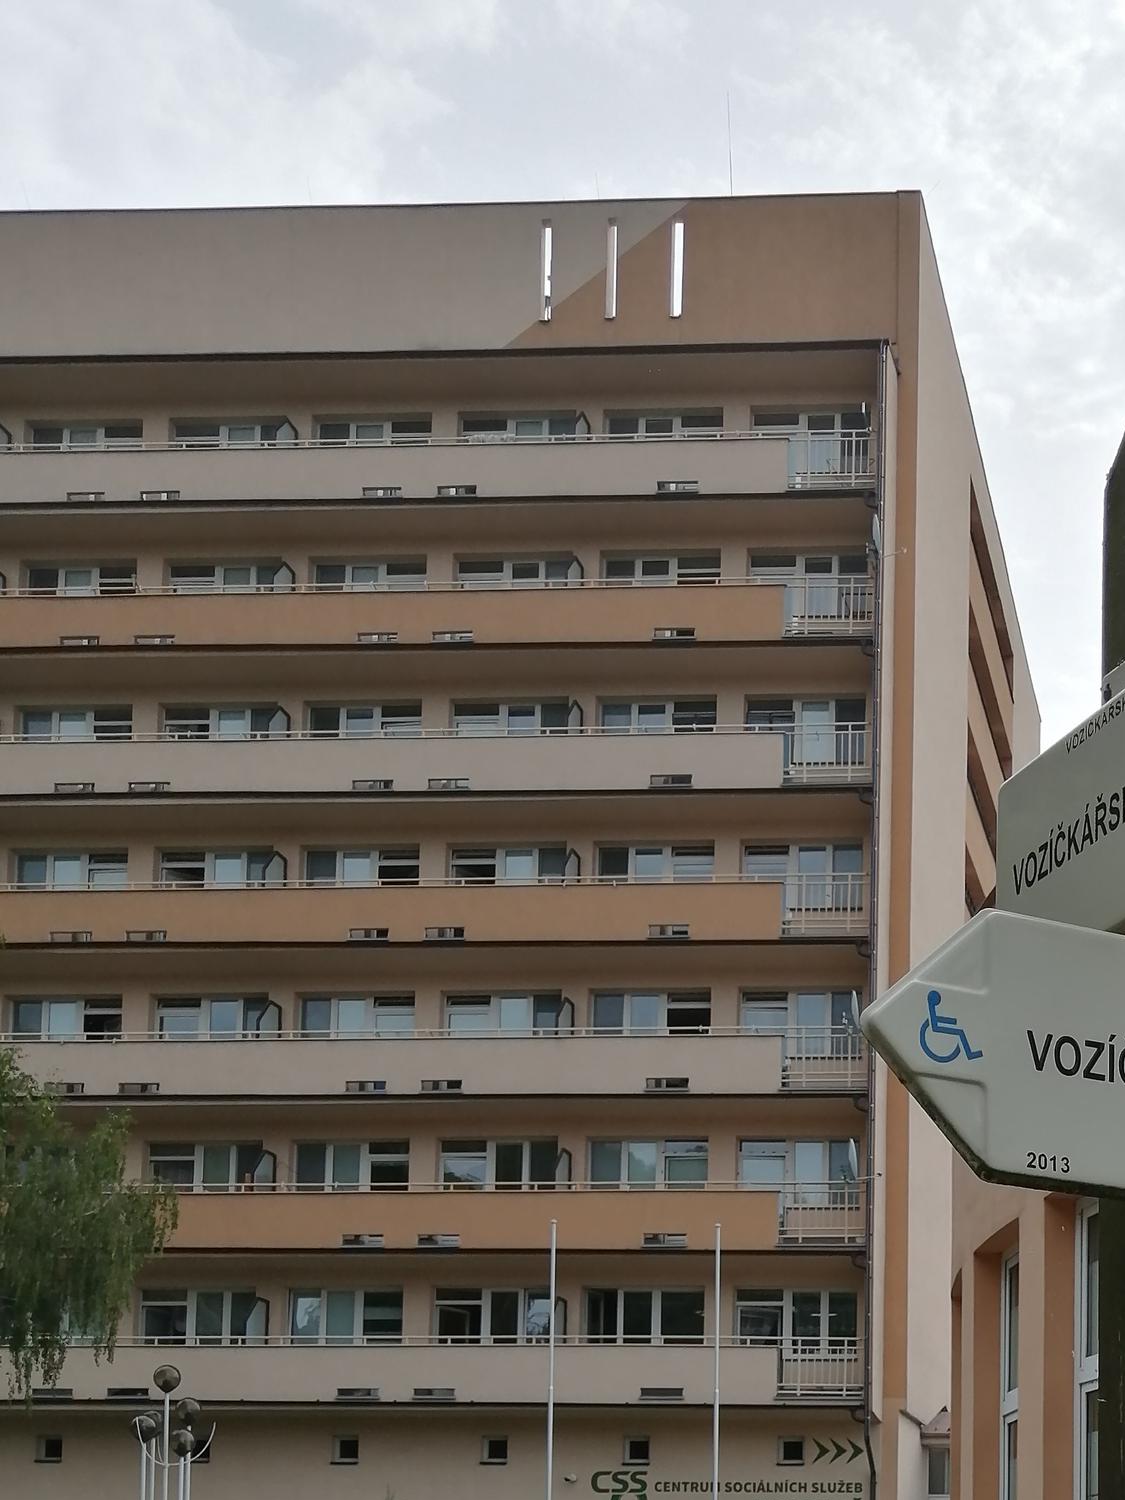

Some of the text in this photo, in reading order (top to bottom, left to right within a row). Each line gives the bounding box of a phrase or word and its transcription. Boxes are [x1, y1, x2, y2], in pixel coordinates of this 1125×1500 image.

[1026, 1151, 1071, 1174] 2013
[591, 1471, 648, 1493] CSS
[724, 1477, 807, 1493] SOCIÁLNÍCH
[811, 1478, 863, 1493] SLUŽEB
